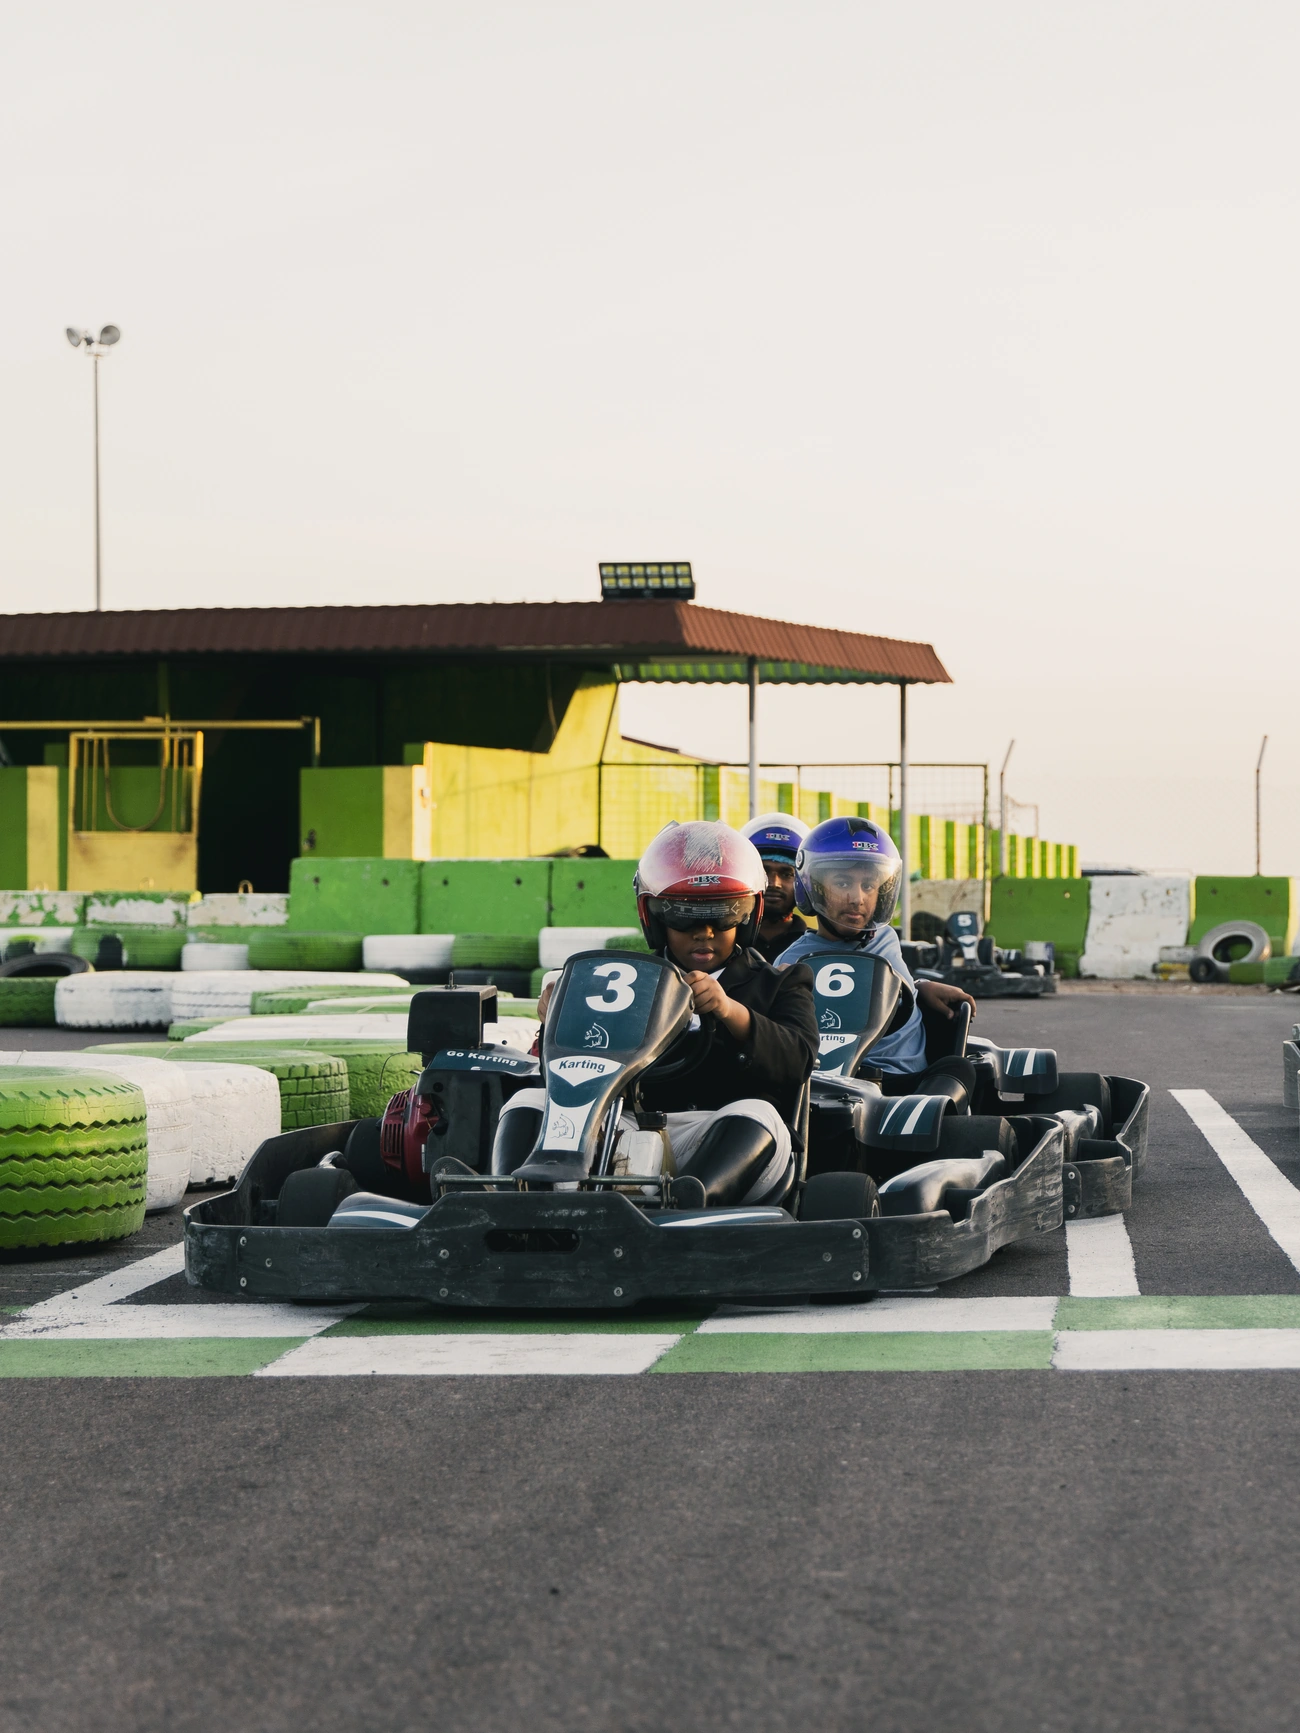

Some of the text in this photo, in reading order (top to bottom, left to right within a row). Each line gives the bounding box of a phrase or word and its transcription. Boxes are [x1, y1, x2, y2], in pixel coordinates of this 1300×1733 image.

[957, 914, 972, 927] 5
[585, 962, 638, 1012] 3
[815, 962, 855, 997] 6
[446, 1050, 518, 1067] Go Karting
[558, 1060, 606, 1073] Karting
